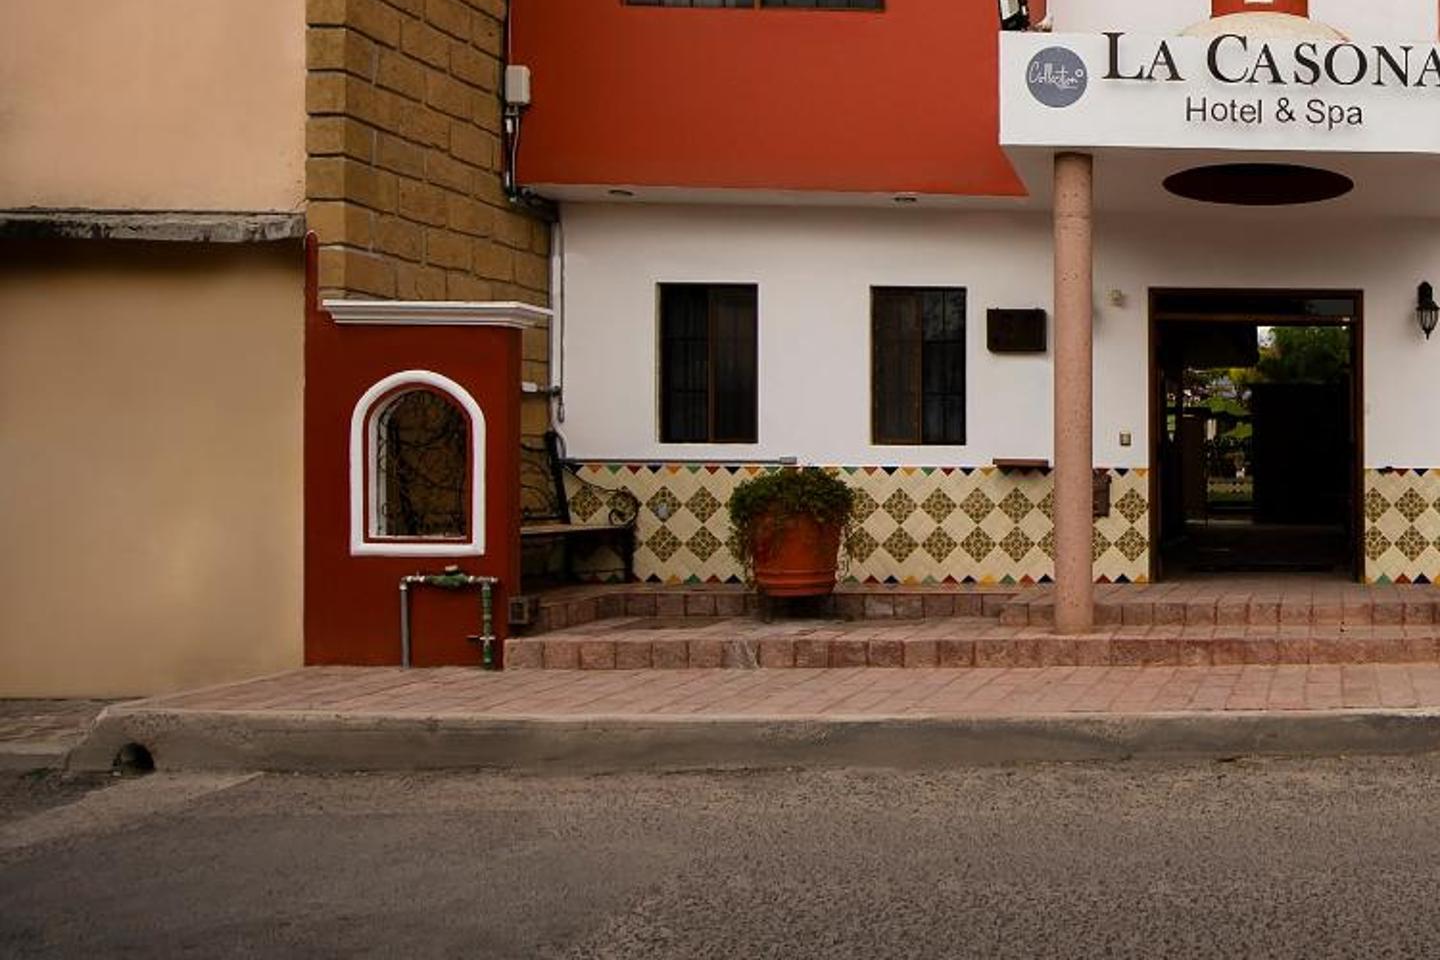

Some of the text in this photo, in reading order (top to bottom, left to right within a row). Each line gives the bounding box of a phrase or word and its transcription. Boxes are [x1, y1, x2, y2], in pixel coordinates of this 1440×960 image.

[1101, 31, 1187, 81] LA
[1185, 96, 1364, 132] Hotel & Spa
